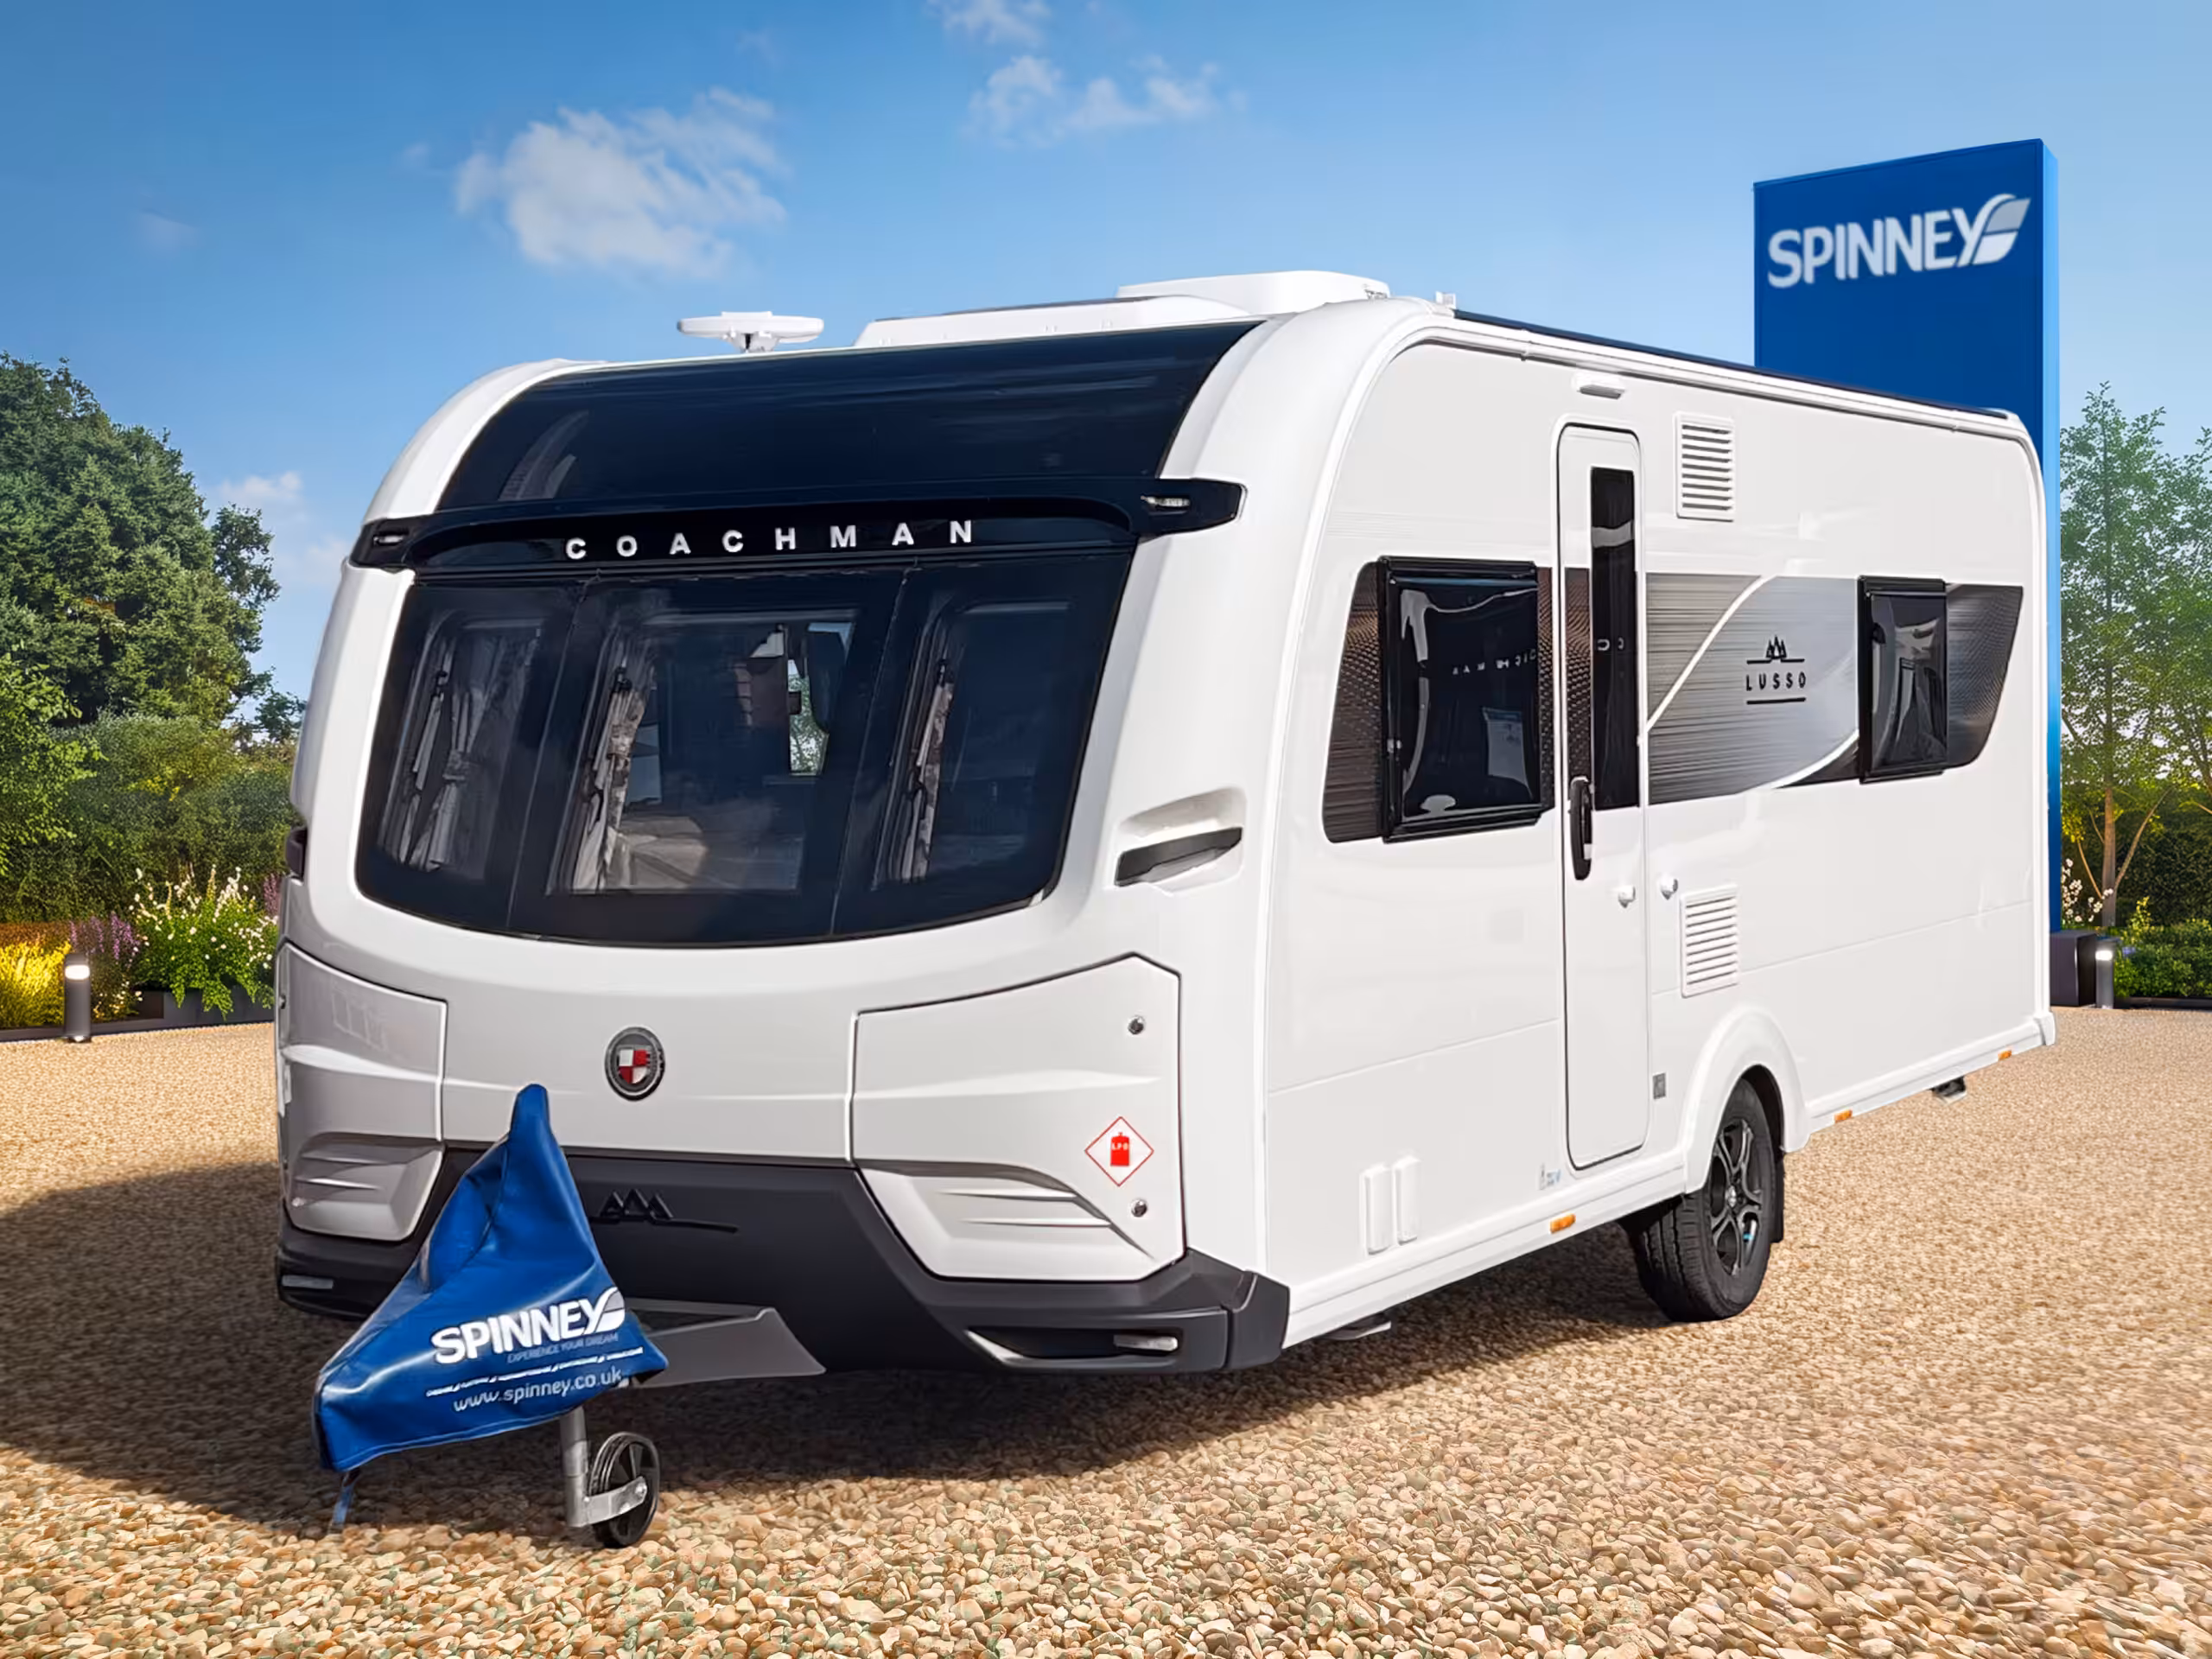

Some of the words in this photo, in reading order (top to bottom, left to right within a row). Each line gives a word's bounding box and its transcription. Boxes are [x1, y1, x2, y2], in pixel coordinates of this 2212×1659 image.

[1768, 194, 2022, 289] SPINNEY
[566, 519, 971, 560] COACHMAN
[1746, 671, 1807, 691] LUSSO
[431, 1287, 621, 1364] SPINNEY
[453, 1366, 622, 1412] www.spinney.co.uk
